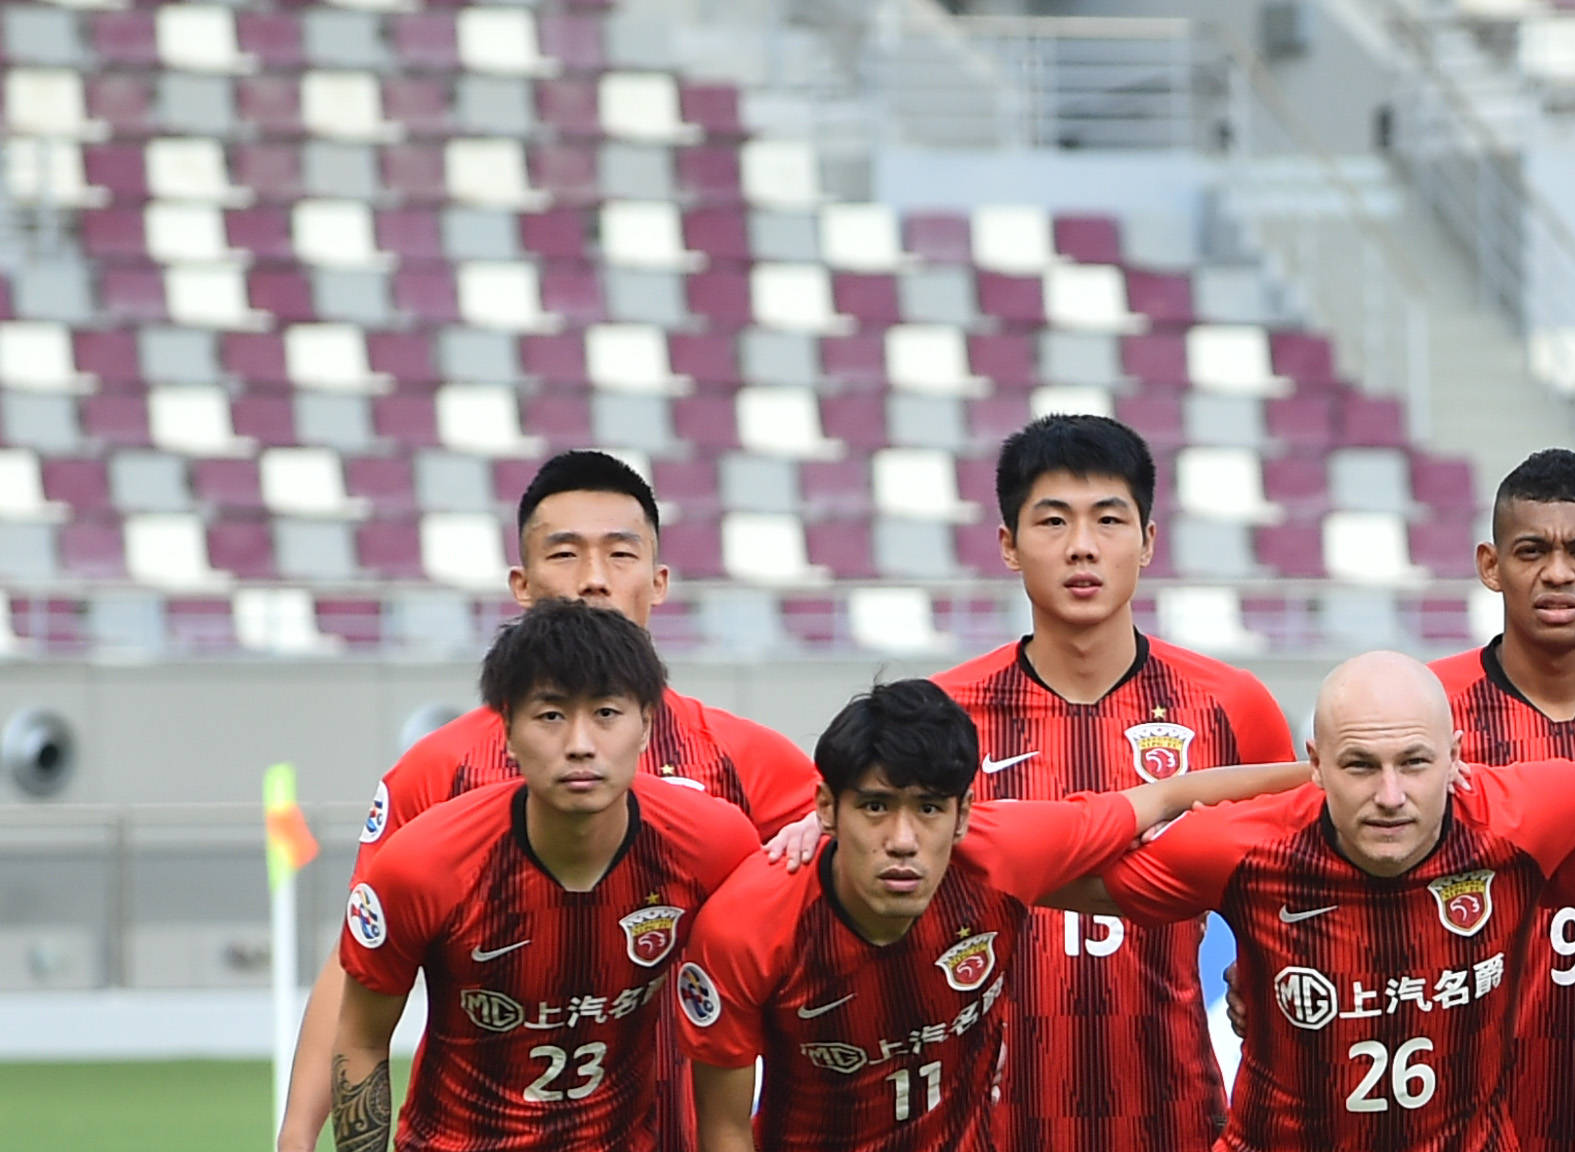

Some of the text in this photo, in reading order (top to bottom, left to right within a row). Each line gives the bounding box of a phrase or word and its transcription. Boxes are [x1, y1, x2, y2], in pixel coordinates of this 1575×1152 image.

[465, 992, 520, 1029] MG
[1278, 952, 1504, 1026] MG 上汽名爵
[523, 1042, 607, 1102] 23
[886, 1061, 942, 1121] 11
[1346, 1036, 1436, 1112] 26
